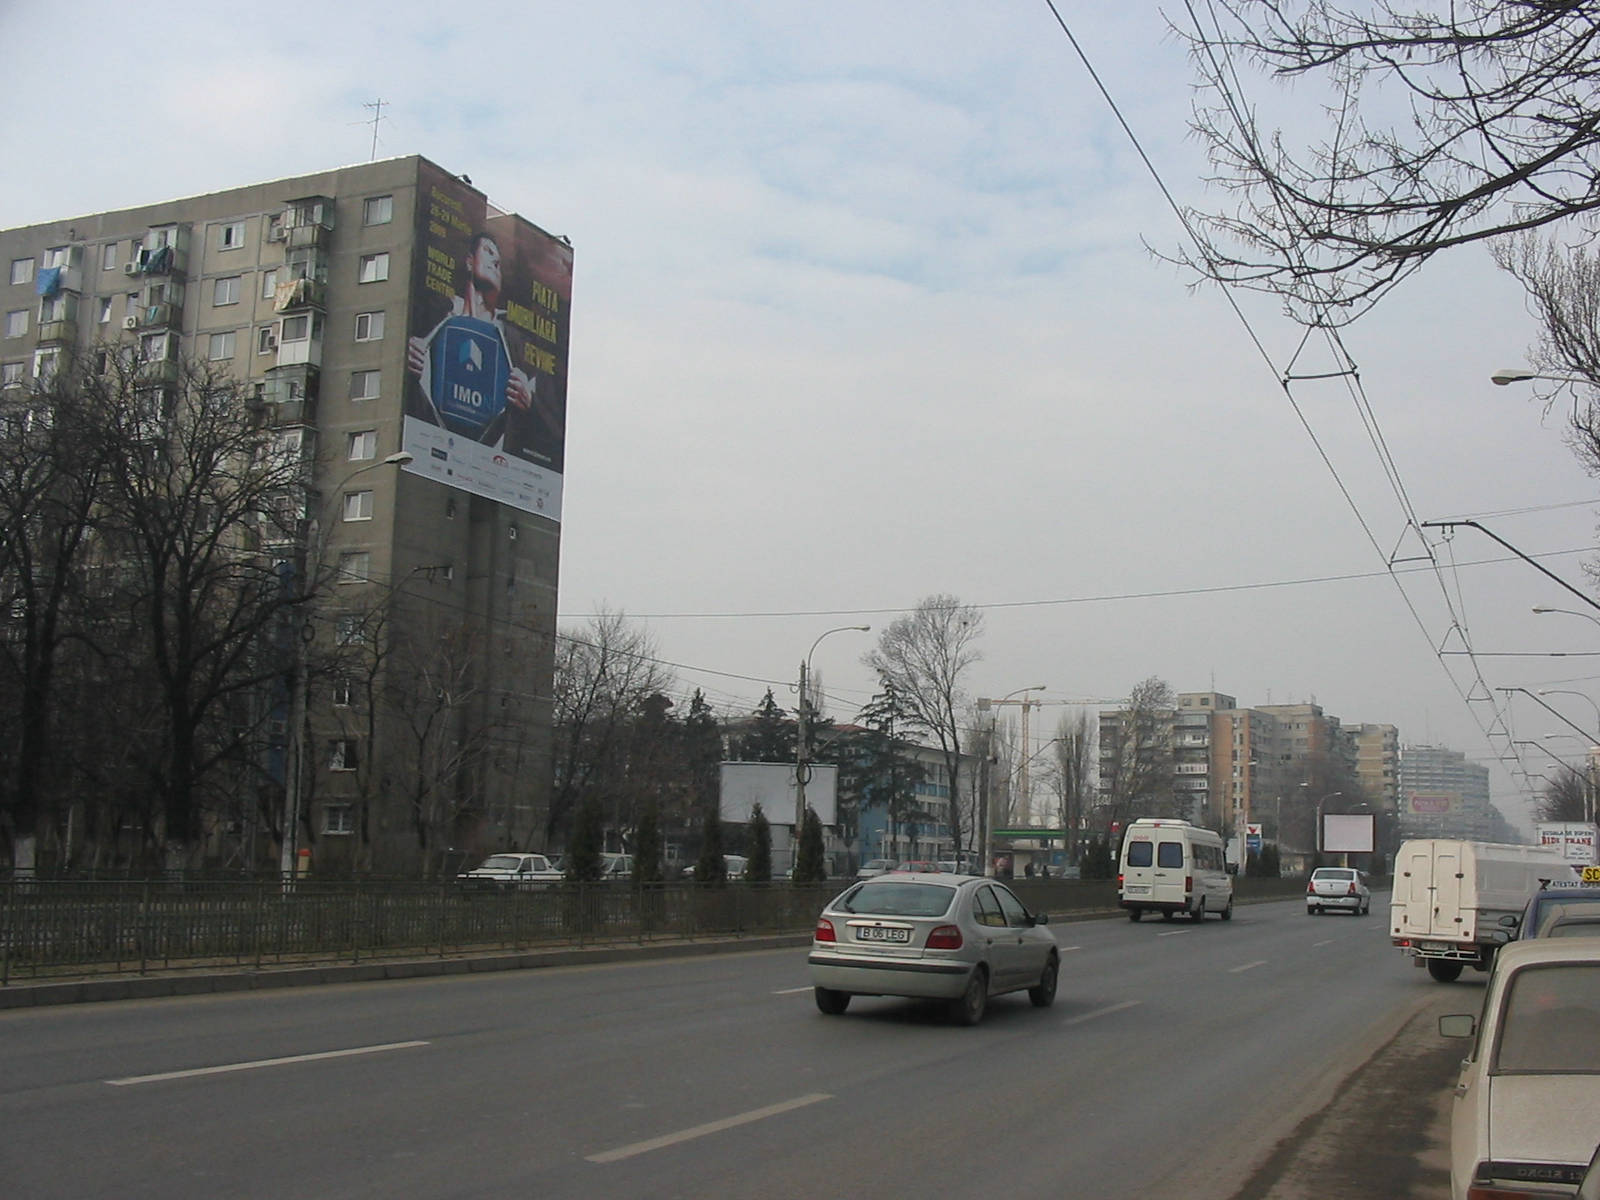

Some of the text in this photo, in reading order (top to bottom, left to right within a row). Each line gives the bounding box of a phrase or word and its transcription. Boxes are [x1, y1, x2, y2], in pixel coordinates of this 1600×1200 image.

[427, 244, 456, 270] WORLD
[427, 260, 452, 284] TRADE
[524, 342, 557, 376] REVINE
[453, 383, 482, 408] IMO
[863, 928, 905, 940] B 06 LEG
